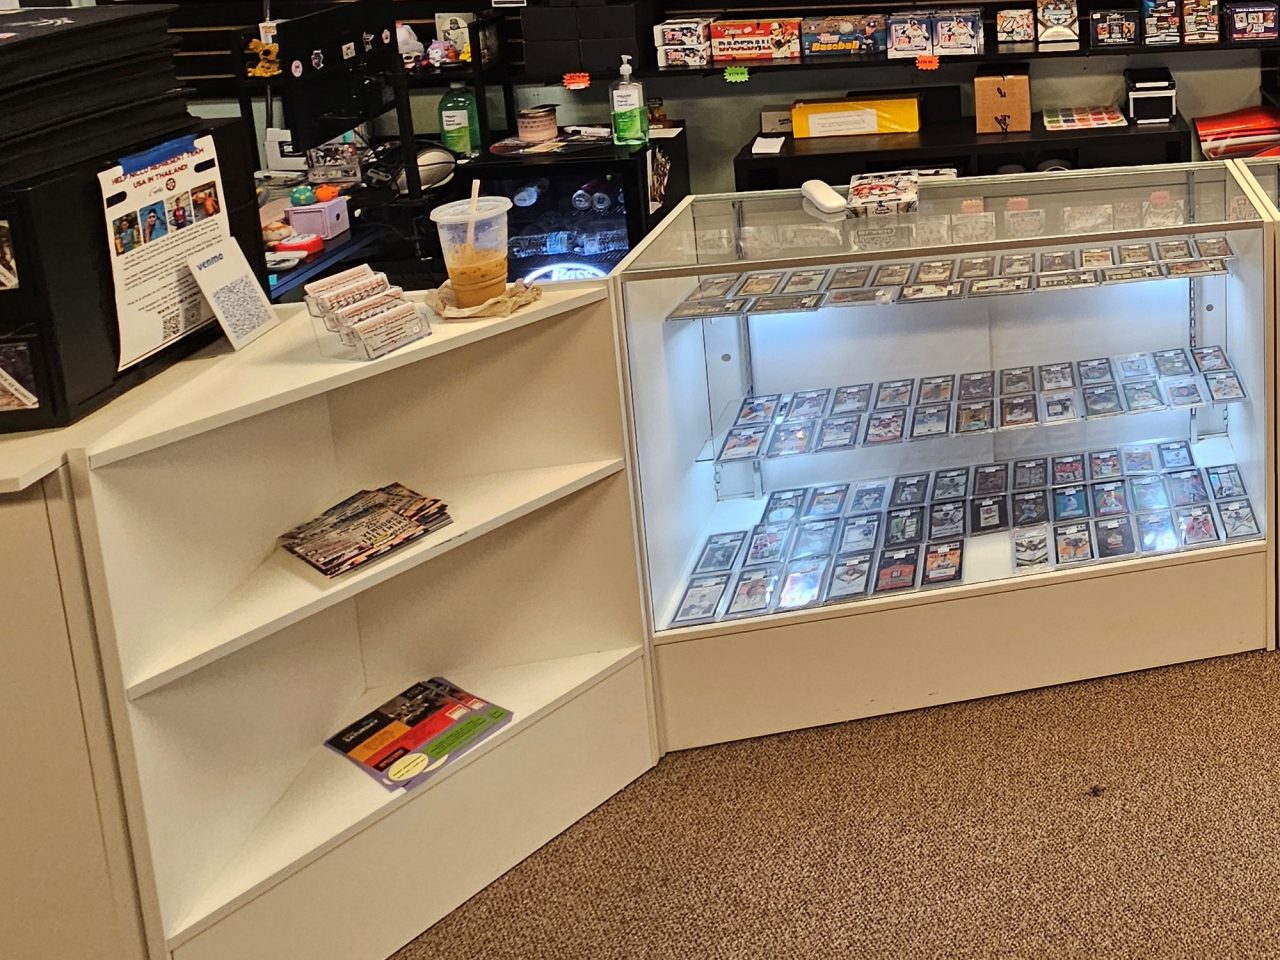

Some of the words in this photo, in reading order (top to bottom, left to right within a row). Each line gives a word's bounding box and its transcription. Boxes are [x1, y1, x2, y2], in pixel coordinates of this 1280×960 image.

[717, 39, 771, 52] BASEBALL
[811, 40, 860, 52] Baseball
[187, 148, 204, 158] TEAM
[132, 179, 146, 189] USA
[196, 252, 225, 271] venmo
[360, 516, 398, 538] VENDORS
